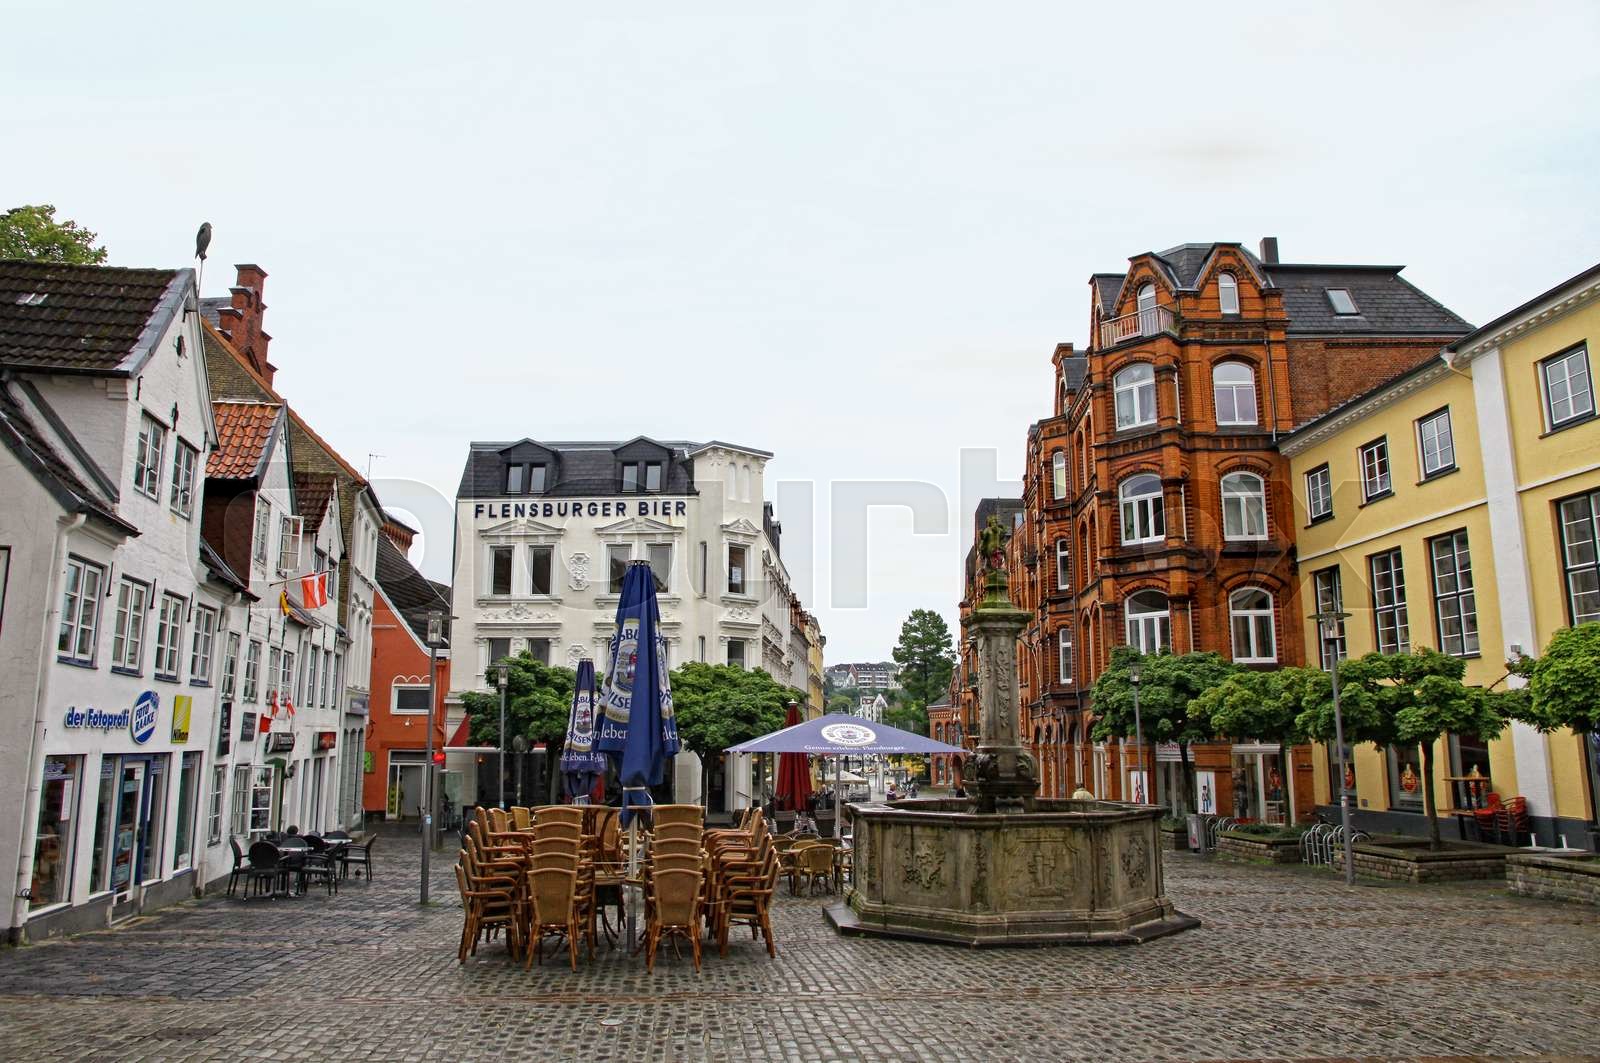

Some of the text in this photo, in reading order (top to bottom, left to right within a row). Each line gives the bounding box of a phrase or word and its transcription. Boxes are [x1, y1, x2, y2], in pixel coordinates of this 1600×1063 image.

[474, 501, 686, 518] FLENSBURGER BIER
[65, 706, 130, 731] der Fotoprofi
[135, 703, 150, 720] FOTO
[173, 729, 189, 740] Nikon
